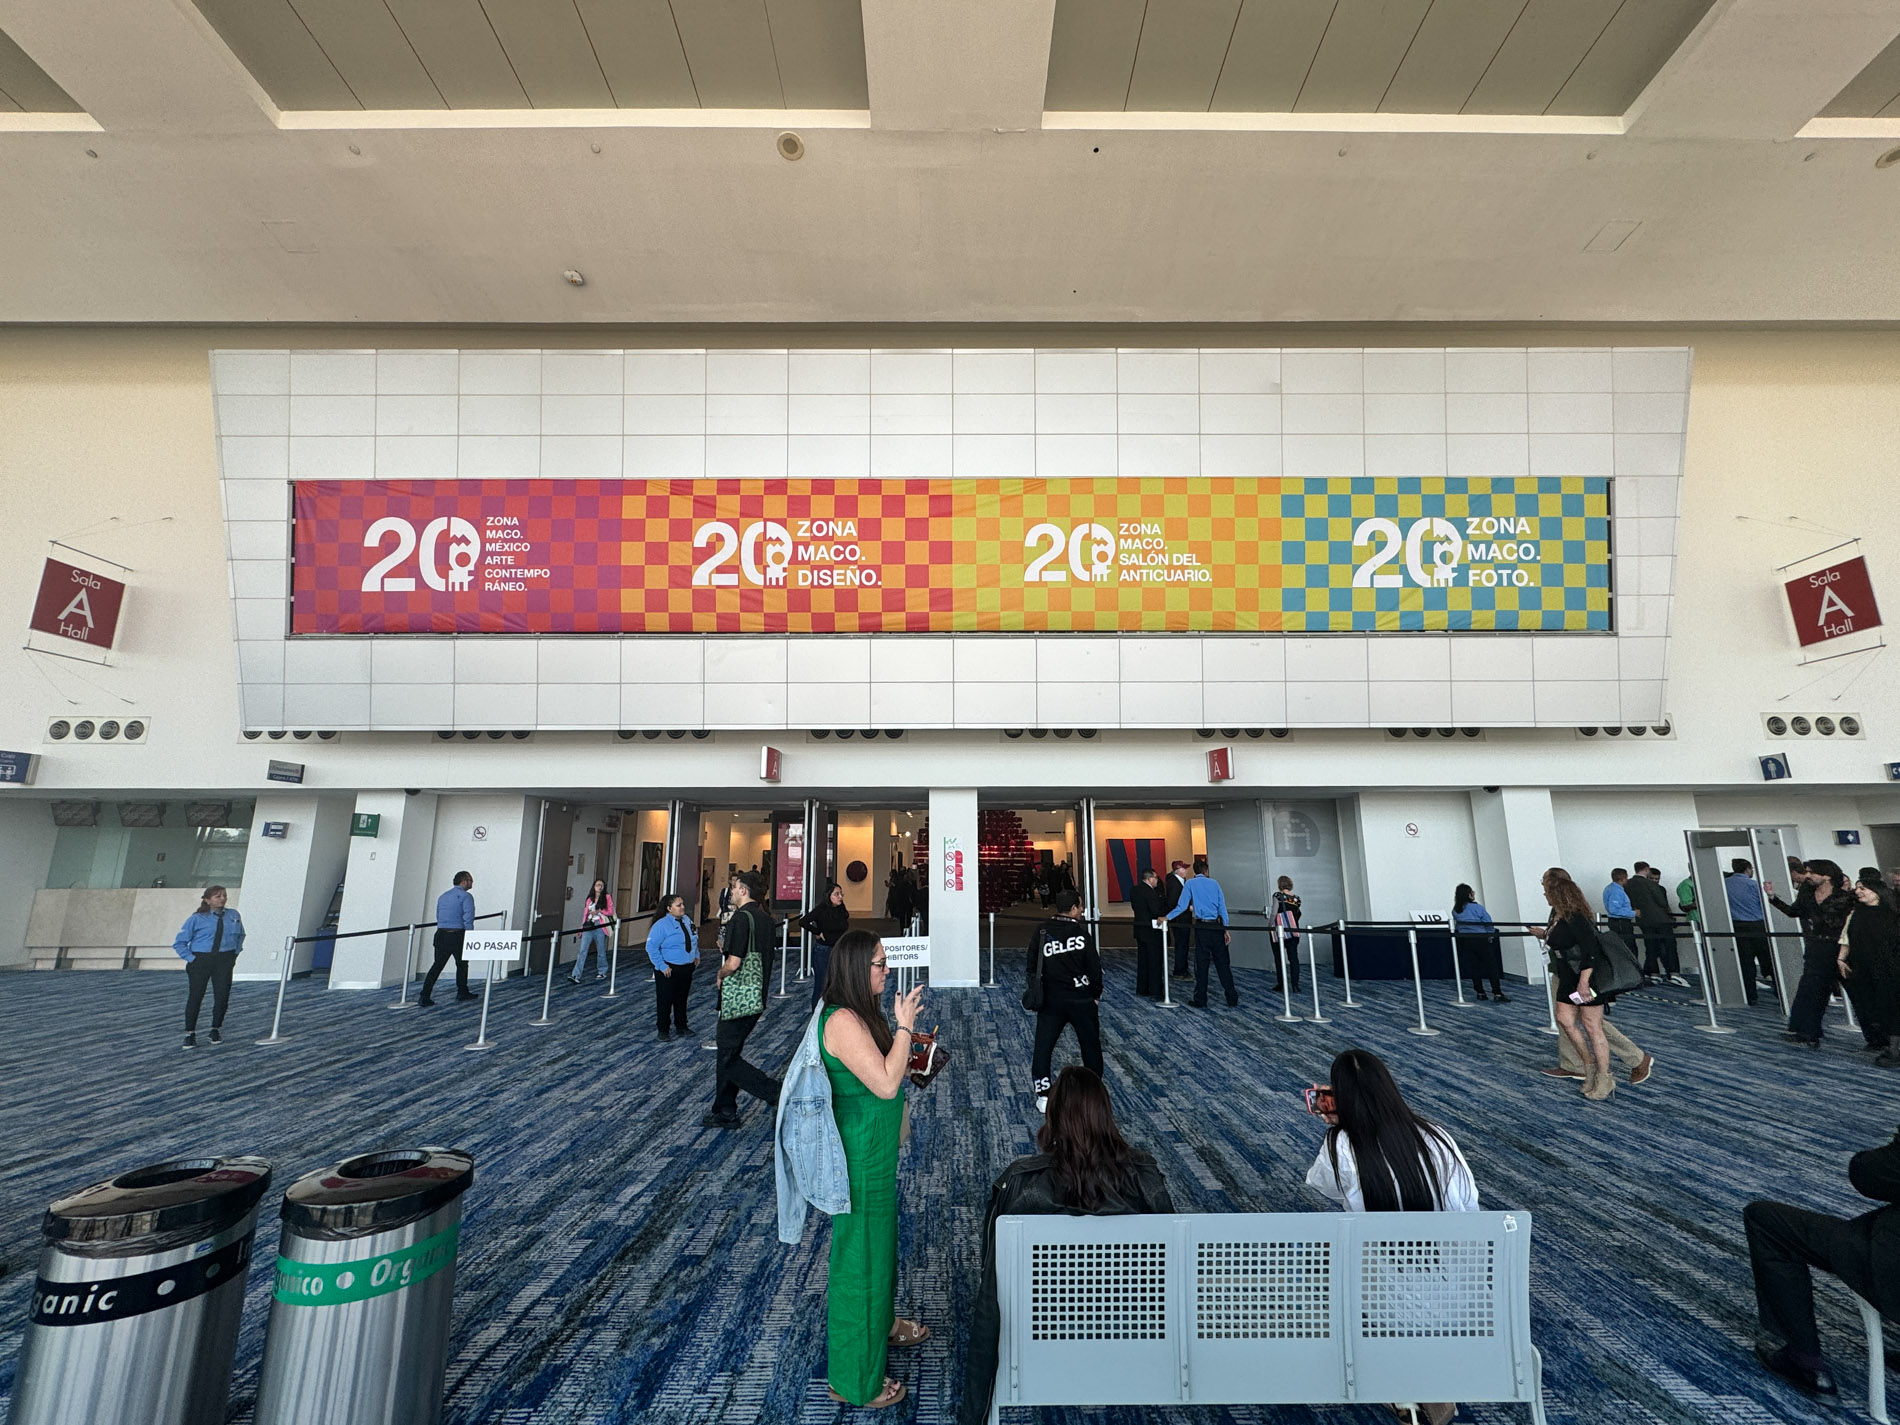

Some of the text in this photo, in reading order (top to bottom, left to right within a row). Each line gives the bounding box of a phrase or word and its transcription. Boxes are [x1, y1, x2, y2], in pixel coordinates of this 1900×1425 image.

[486, 516, 519, 526] ZONA
[1465, 517, 1531, 535] ZONA
[486, 529, 524, 539] MACO.
[797, 521, 857, 537] ZONA
[1119, 523, 1161, 535] ZONA
[485, 540, 530, 552] MÉXICO
[1119, 538, 1168, 550] MACO.
[797, 545, 866, 561] MACO.
[1119, 551, 1201, 566] SALÓN DEL
[1467, 543, 1541, 561] MACO.
[485, 555, 515, 565] ARTE
[70, 569, 101, 590] Sala
[484, 568, 550, 578] CONTEMPO
[798, 565, 882, 586] DISEÑO.
[1119, 569, 1212, 582] ANTICUARIO.
[1468, 569, 1535, 587] FOTO.
[1809, 570, 1841, 588] Sala
[484, 580, 528, 591] RÁNEO.
[57, 587, 94, 629] A
[1817, 585, 1855, 627] A
[59, 621, 89, 640] Hall
[1823, 618, 1853, 638] Hall
[772, 761, 778, 776] A
[1214, 761, 1221, 776] A
[466, 941, 518, 950] NO PASAR
[883, 944, 928, 952] POSITORES/
[1043, 936, 1085, 957] GELES
